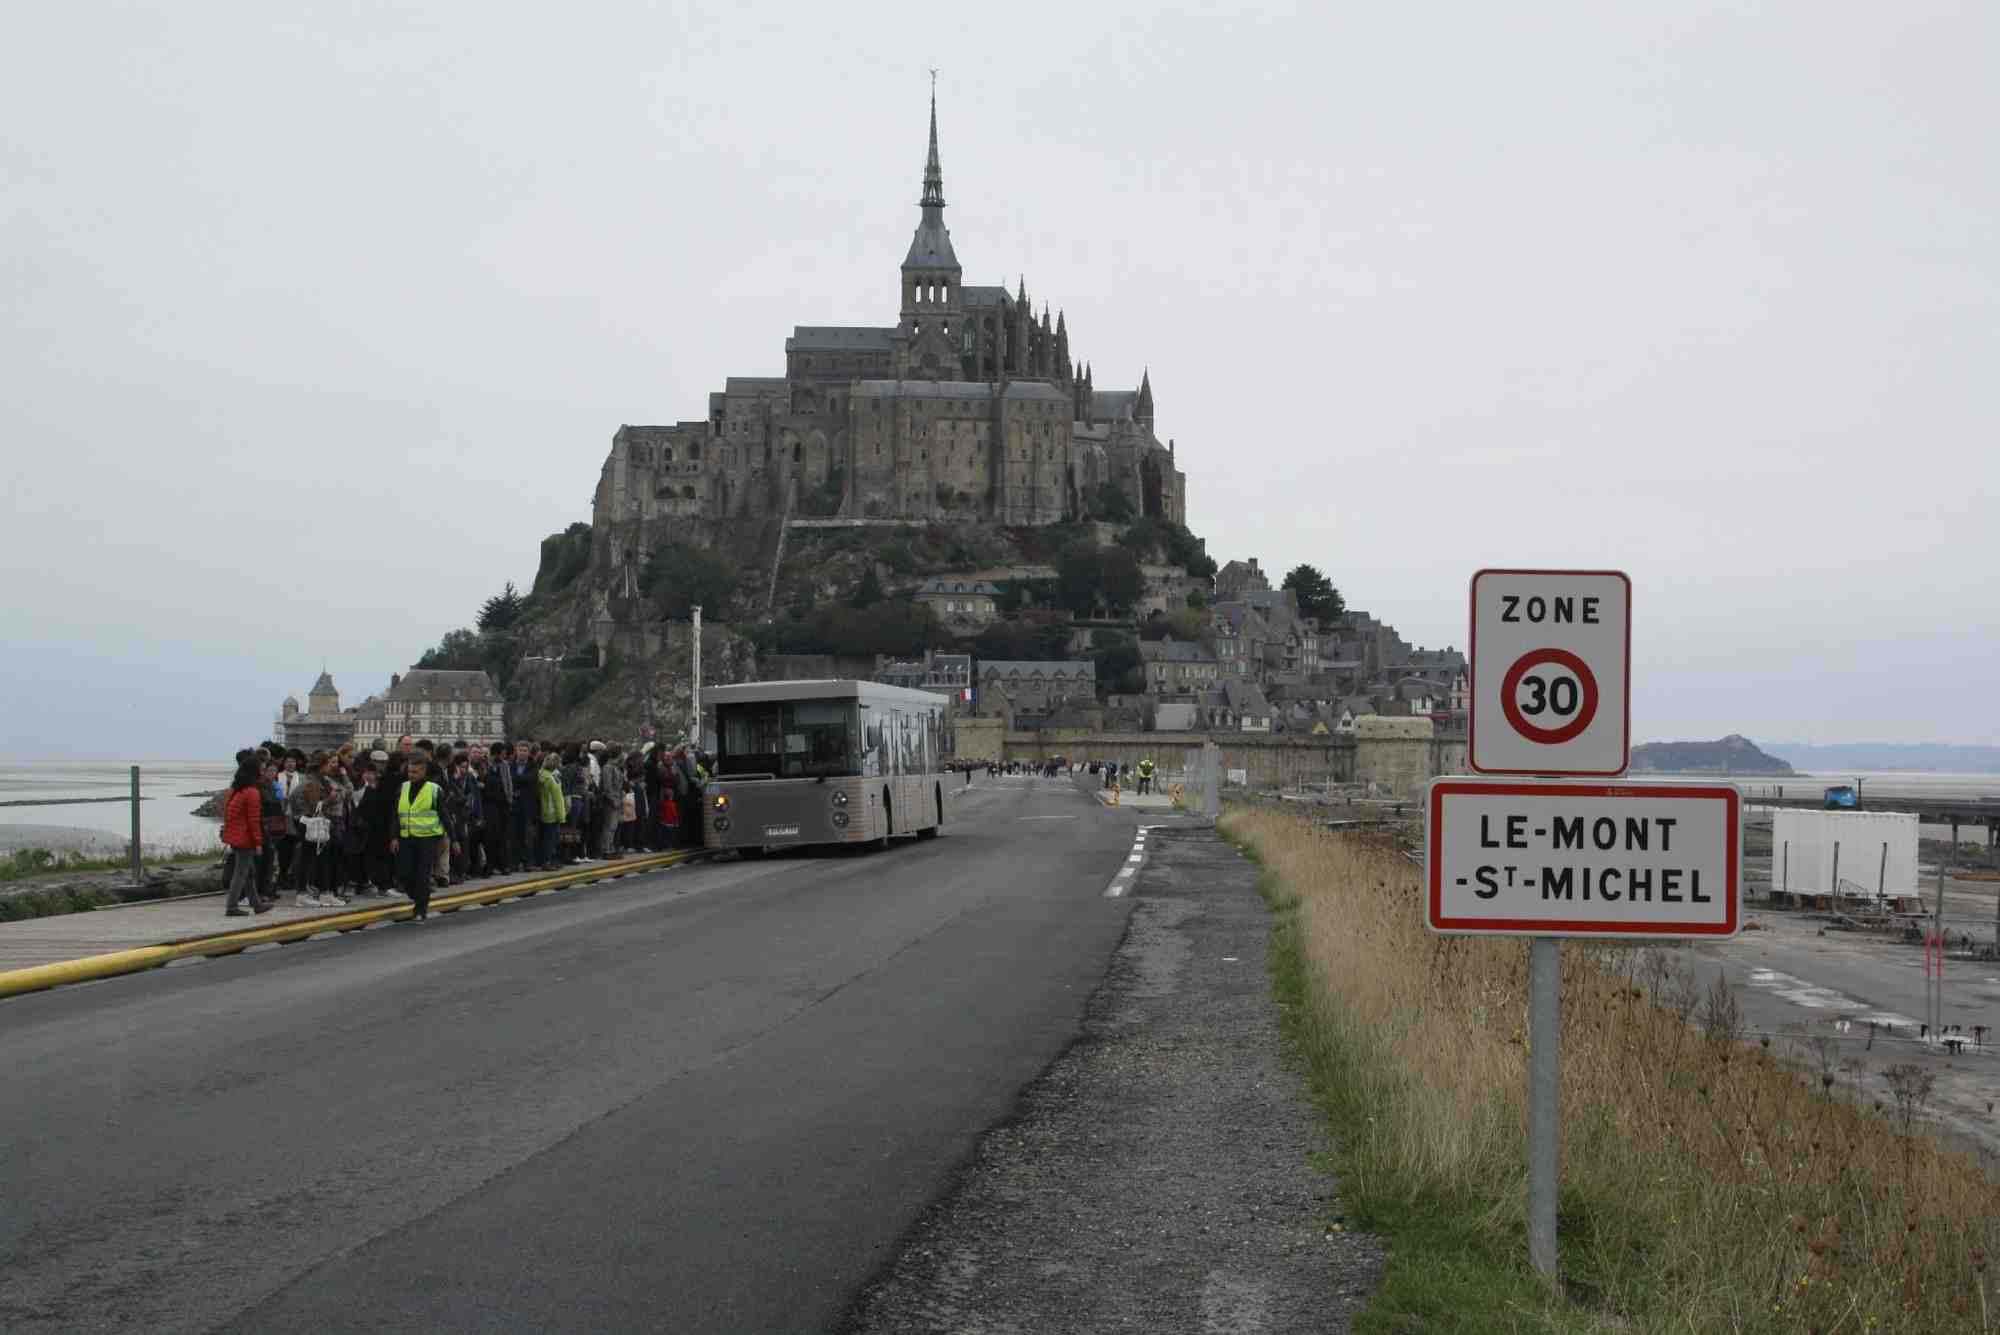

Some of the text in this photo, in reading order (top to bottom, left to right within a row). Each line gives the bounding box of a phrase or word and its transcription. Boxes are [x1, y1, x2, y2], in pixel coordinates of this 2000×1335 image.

[1501, 595, 1600, 624] ZONE
[1520, 676, 1578, 716] 30
[1480, 815, 1677, 851] LE-MONT
